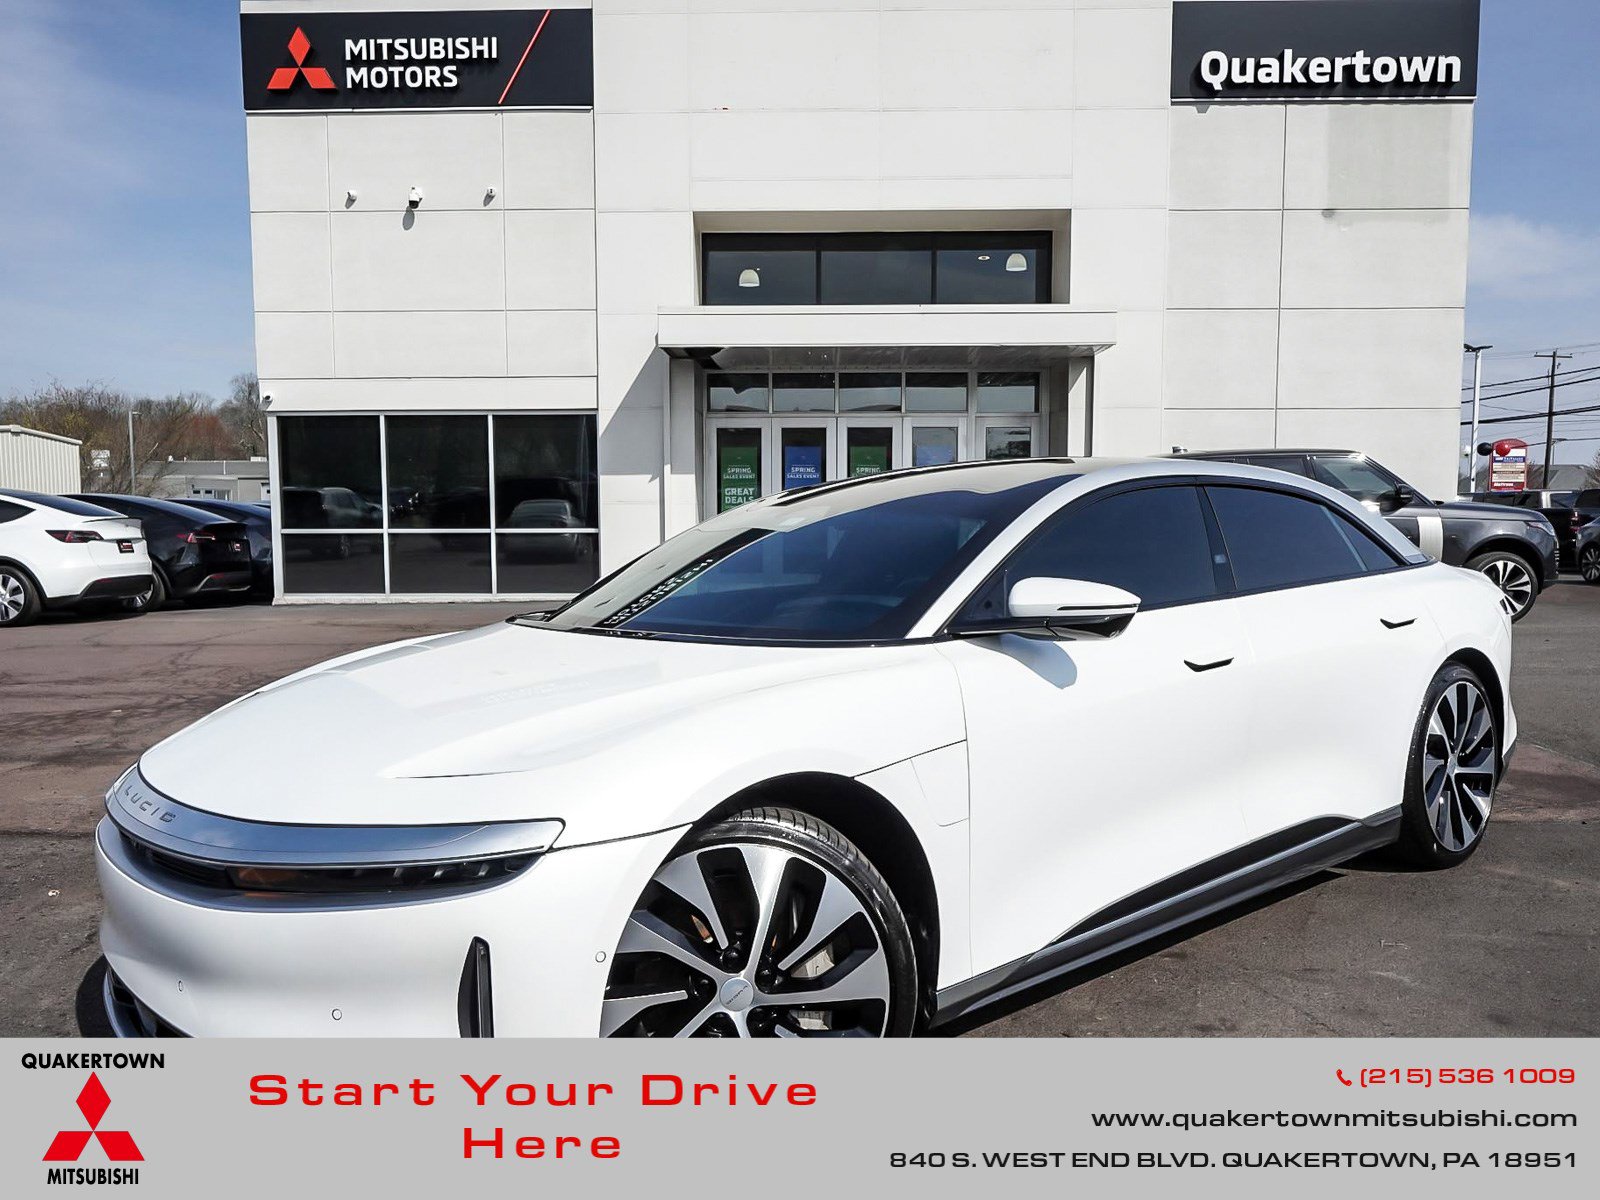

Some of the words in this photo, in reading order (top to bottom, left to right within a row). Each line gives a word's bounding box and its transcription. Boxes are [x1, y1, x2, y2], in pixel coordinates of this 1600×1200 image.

[345, 36, 498, 61] MITSUBISHI
[346, 65, 458, 89] MOTORS
[1200, 48, 1462, 91] Quakertown
[725, 487, 754, 496] GREAT
[125, 785, 176, 823] LUCID
